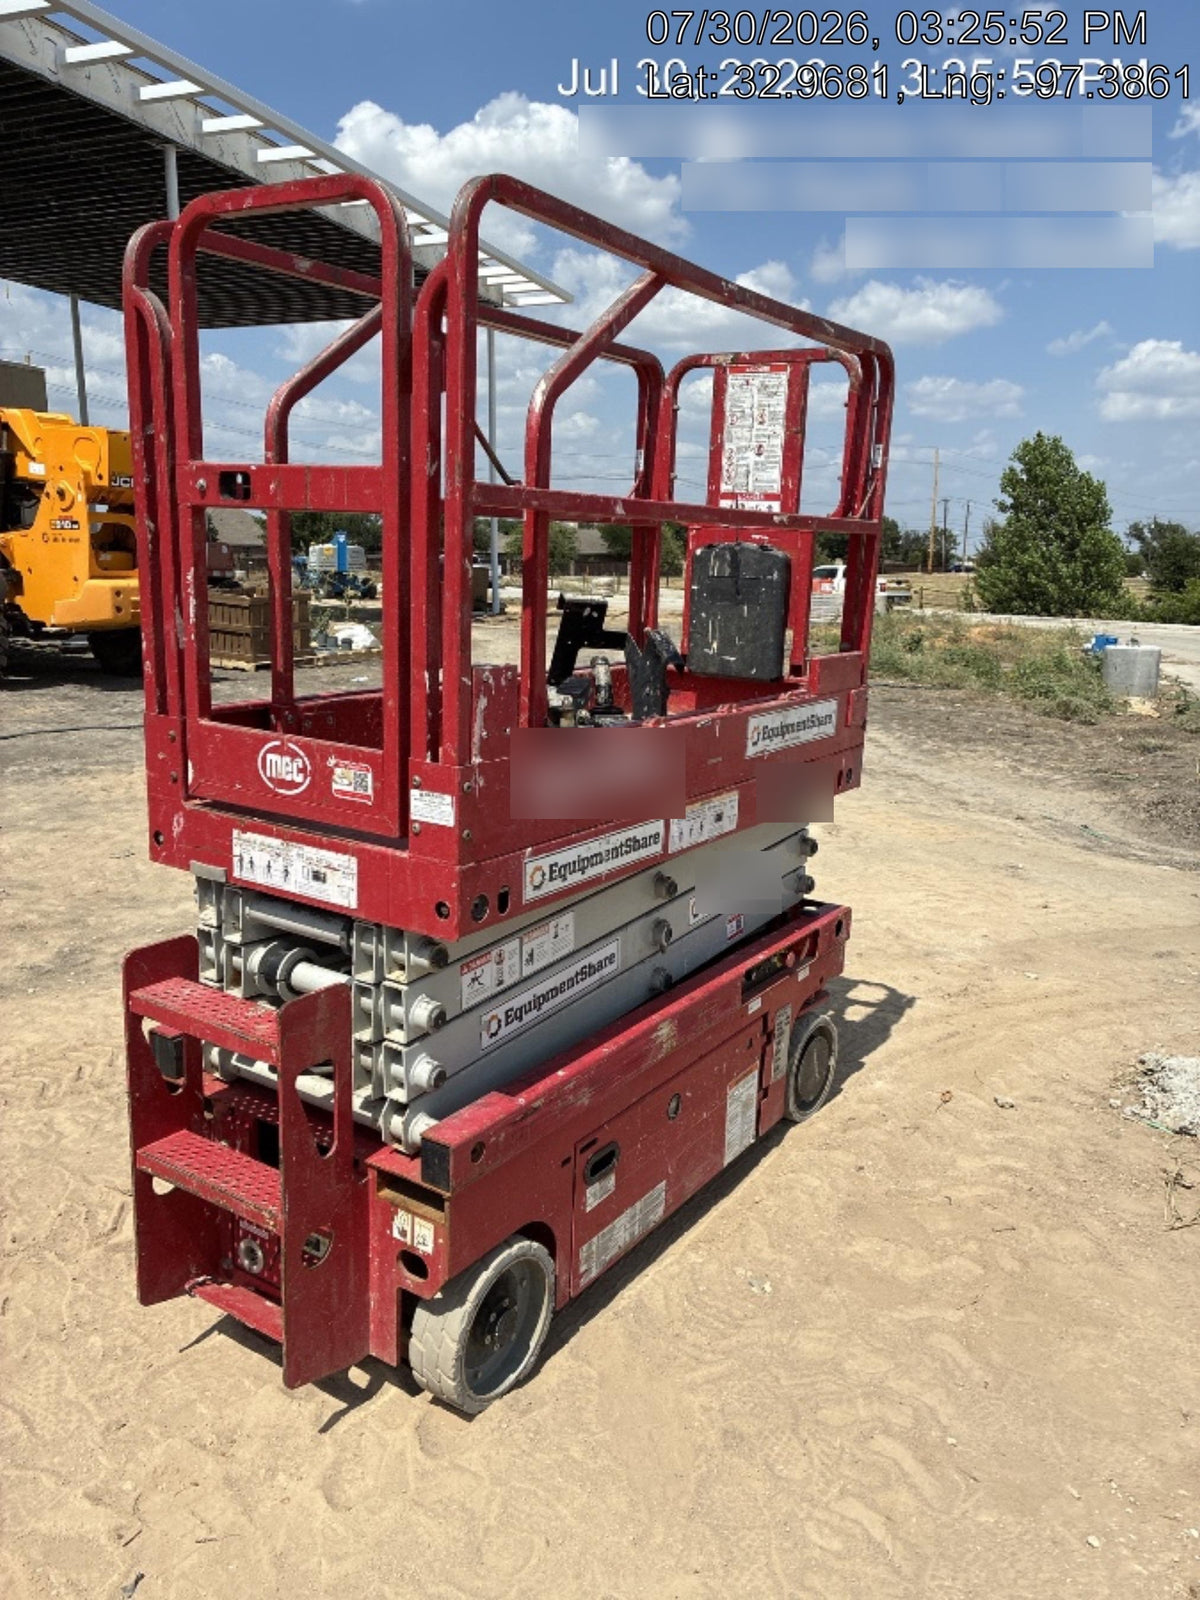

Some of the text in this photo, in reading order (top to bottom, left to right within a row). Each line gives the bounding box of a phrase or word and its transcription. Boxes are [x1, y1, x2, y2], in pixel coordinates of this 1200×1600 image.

[111, 476, 134, 487] JC
[548, 831, 660, 882] EquipmentShare
[504, 952, 616, 1027] EquipmentShare
